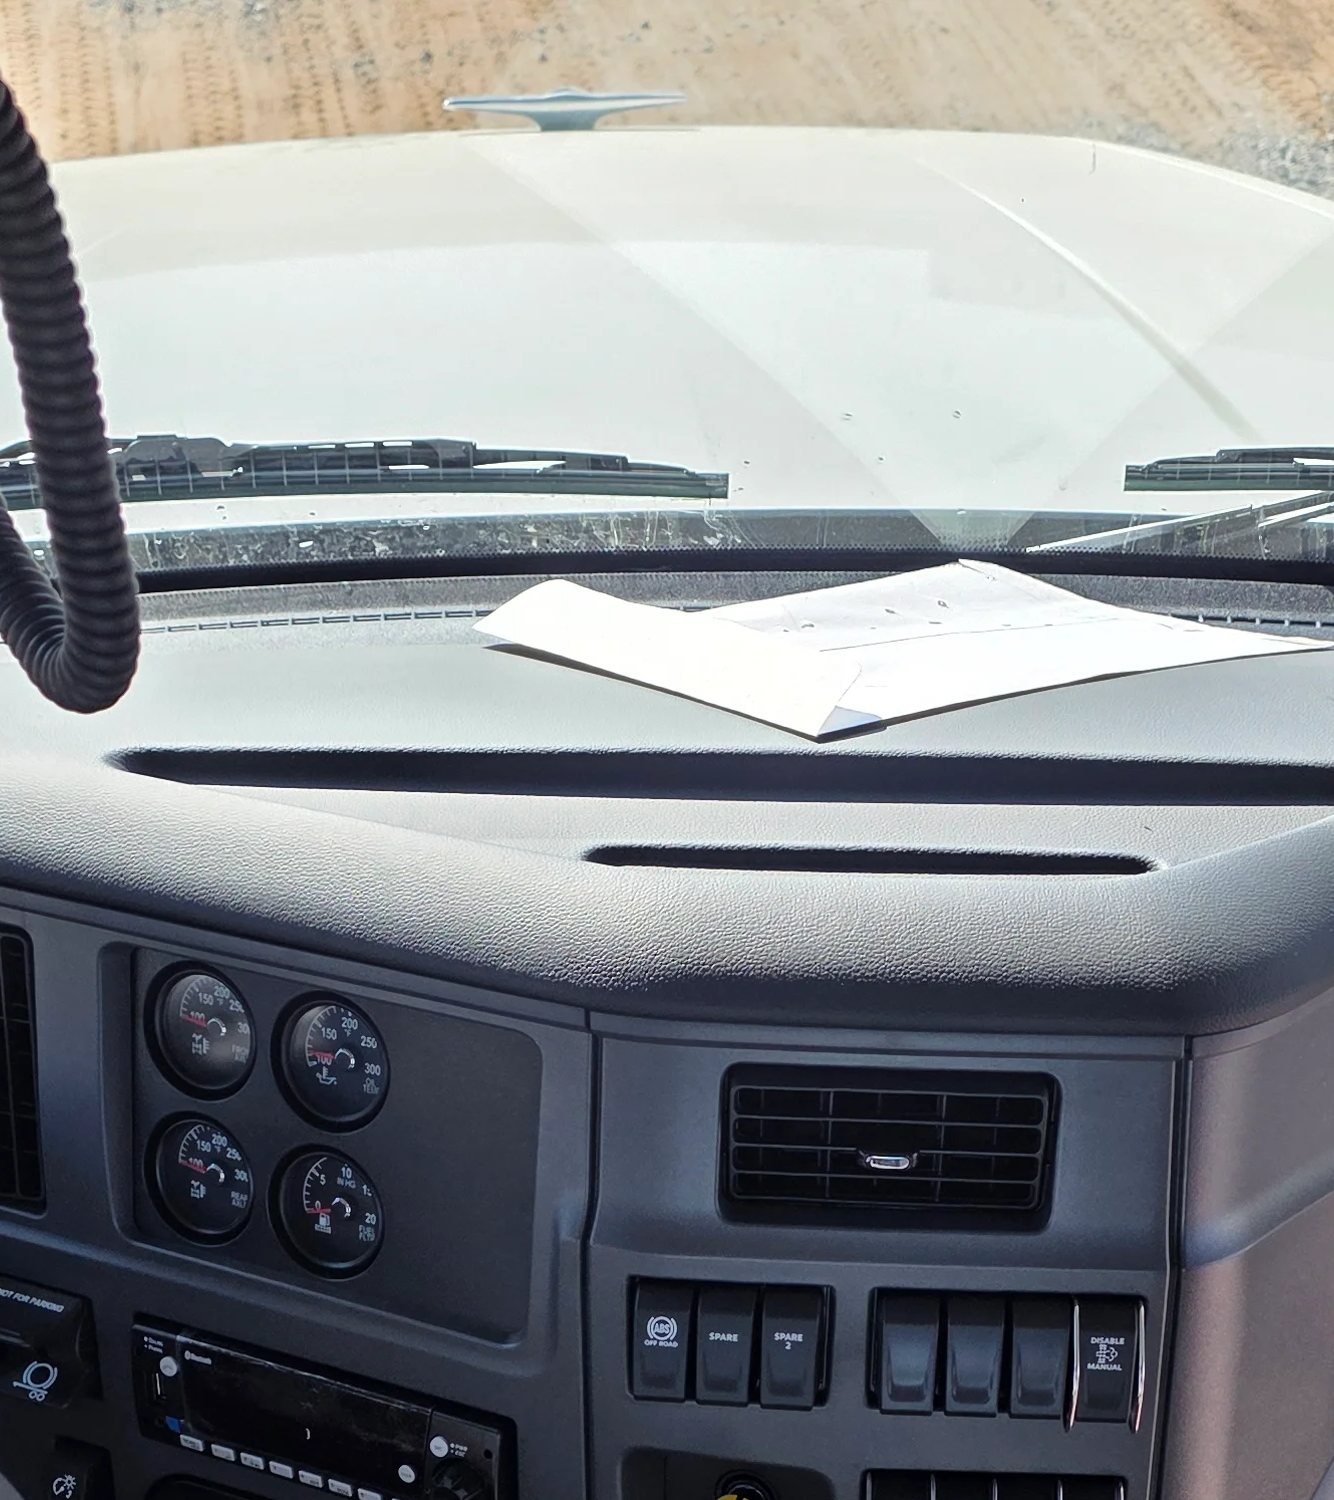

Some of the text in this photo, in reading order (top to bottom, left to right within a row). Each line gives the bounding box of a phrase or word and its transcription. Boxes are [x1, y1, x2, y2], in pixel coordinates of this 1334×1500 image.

[214, 986, 231, 998] 200
[198, 993, 214, 1005] 150
[341, 1017, 358, 1030] 200
[321, 1027, 337, 1040] 150
[360, 1035, 378, 1049] 250
[365, 1063, 381, 1076] 300
[196, 1140, 211, 1152] 150
[211, 1133, 227, 1147] 200
[341, 1166, 352, 1179] 10
[319, 1174, 327, 1185] 5
[365, 1212, 376, 1225] 20
[13, 1292, 31, 1304] FOR
[653, 1322, 671, 1334] ABS
[643, 1339, 657, 1347] OFF
[708, 1332, 739, 1342] SPARE
[774, 1332, 804, 1342] SPARE
[1090, 1336, 1125, 1345] DISABLE
[784, 1341, 792, 1350] 2
[1087, 1362, 1123, 1371] MANUAL
